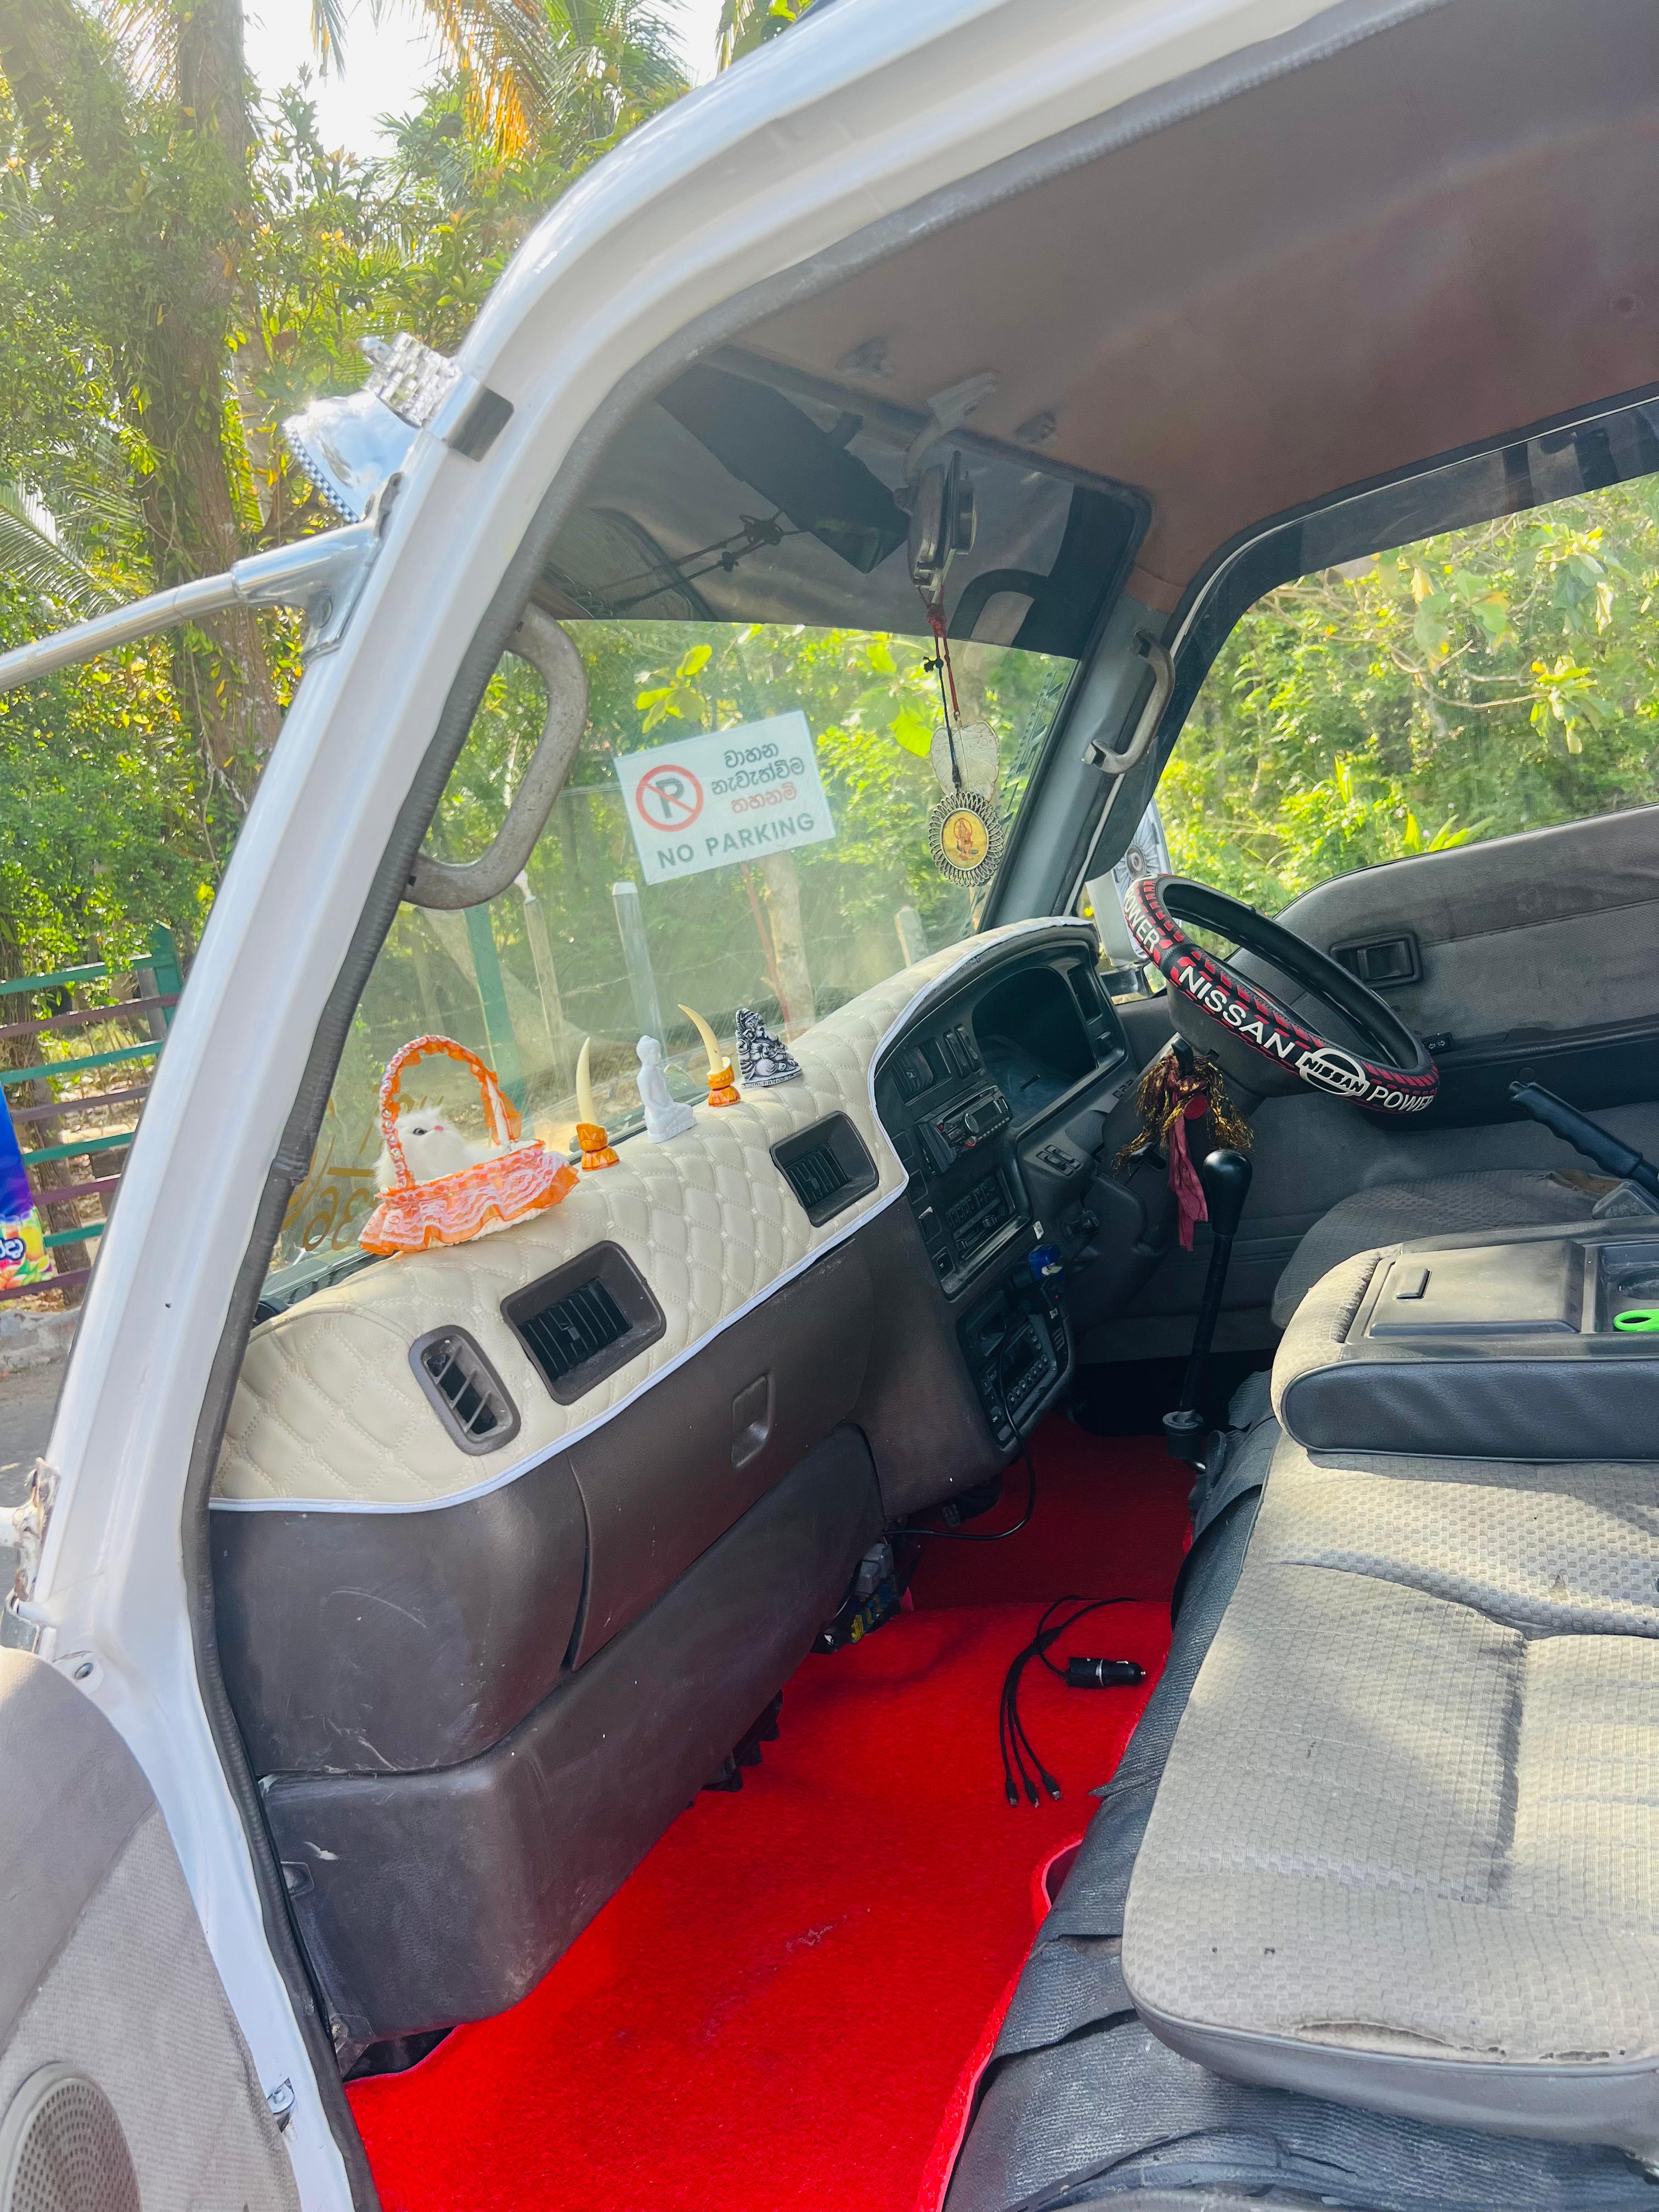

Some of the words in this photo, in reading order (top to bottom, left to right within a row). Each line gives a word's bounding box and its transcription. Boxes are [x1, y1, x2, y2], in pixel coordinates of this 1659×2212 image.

[724, 742, 779, 769] වාහන
[731, 781, 797, 814] තහනම්
[658, 844, 695, 869] NO
[706, 812, 815, 857] PARKING
[1179, 965, 1296, 1059] NISSAN
[1302, 1057, 1365, 1093] NISSAN
